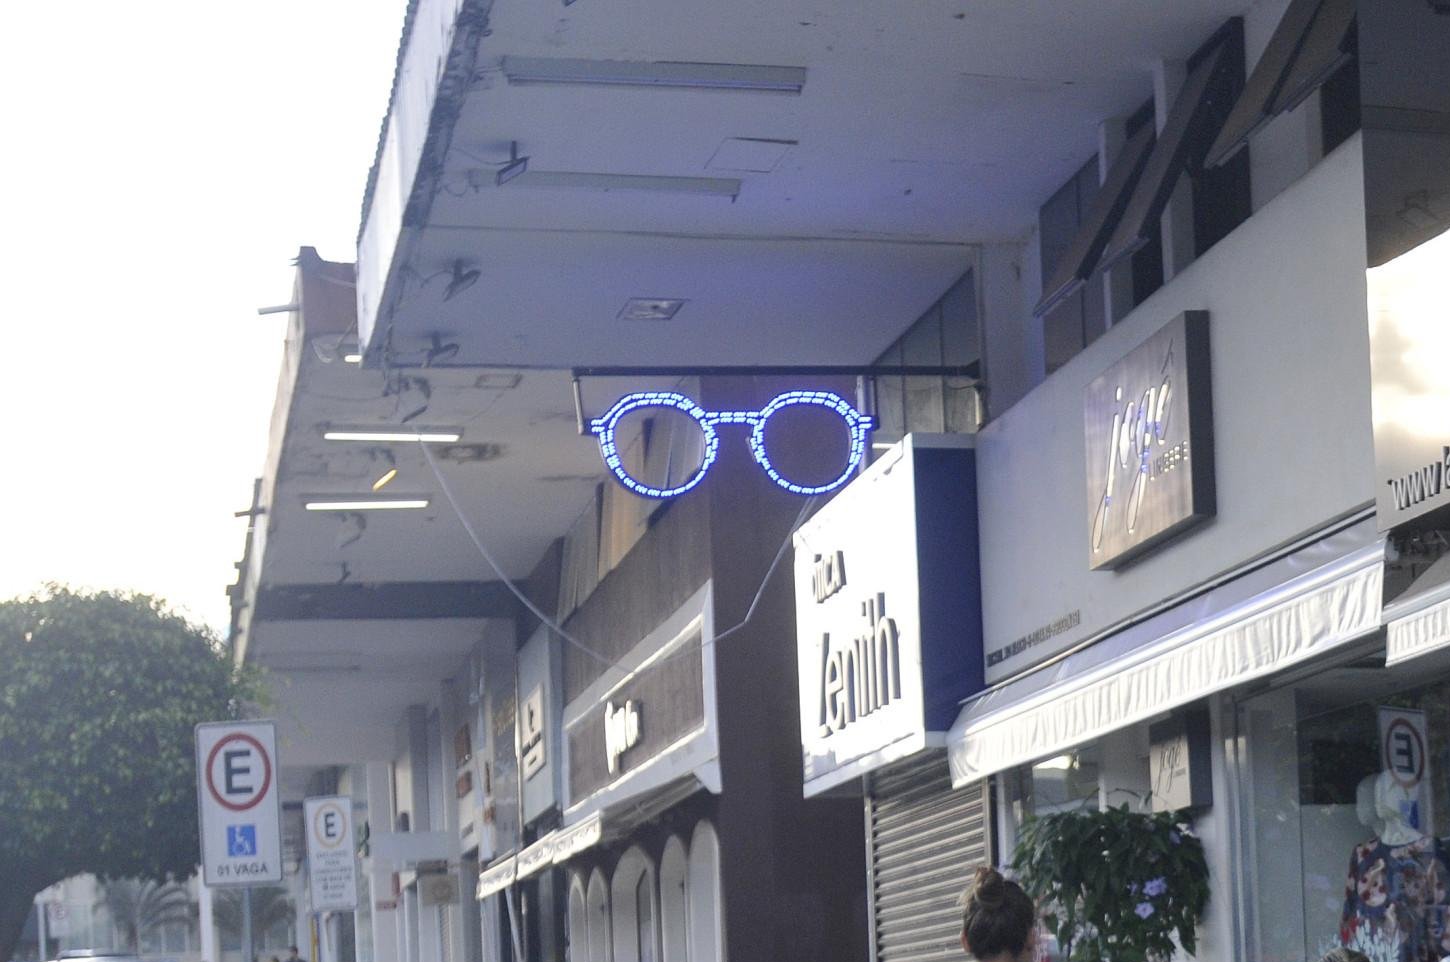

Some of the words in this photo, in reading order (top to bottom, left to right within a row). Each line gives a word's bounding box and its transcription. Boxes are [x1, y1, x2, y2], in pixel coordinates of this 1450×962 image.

[814, 592, 901, 739] Zenith
[224, 750, 253, 794] E
[324, 812, 336, 838] E
[234, 862, 268, 876] VAGA
